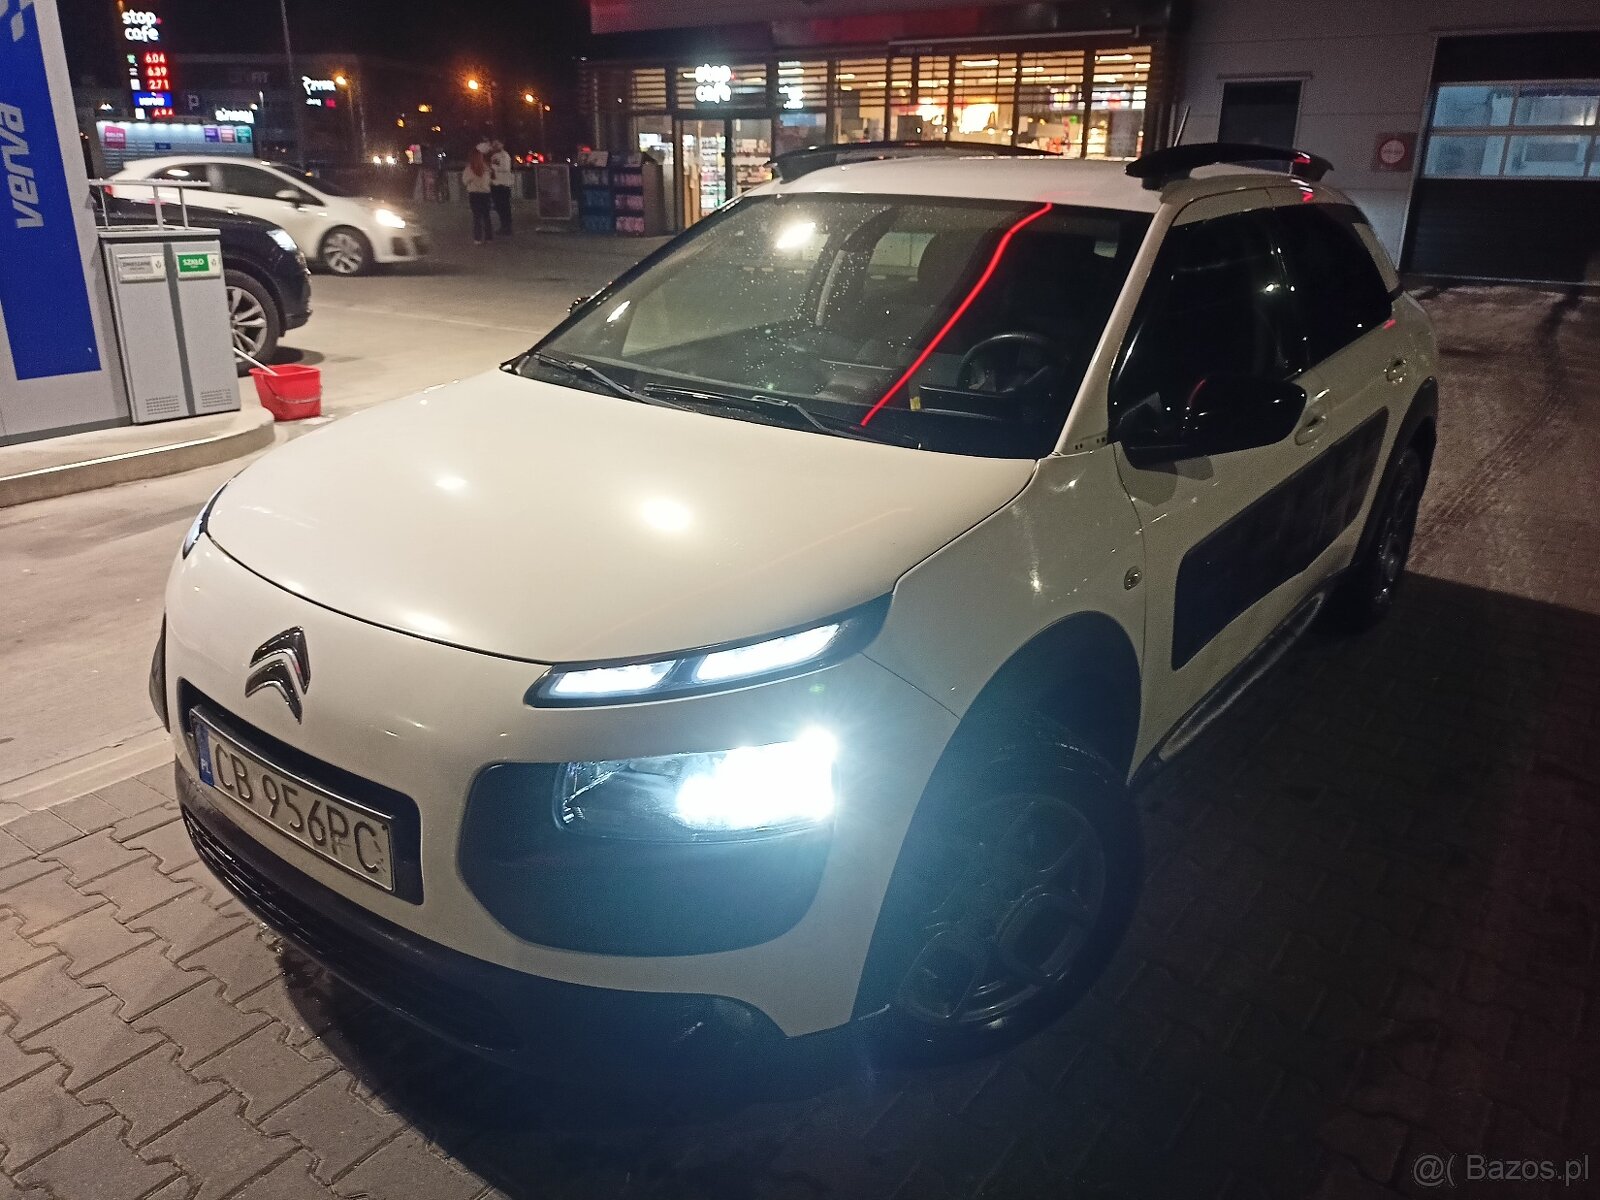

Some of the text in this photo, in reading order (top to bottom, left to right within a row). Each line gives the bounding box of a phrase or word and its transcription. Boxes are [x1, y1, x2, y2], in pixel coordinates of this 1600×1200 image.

[0, 103, 45, 229] verva
[214, 743, 380, 874] CB 956PC
